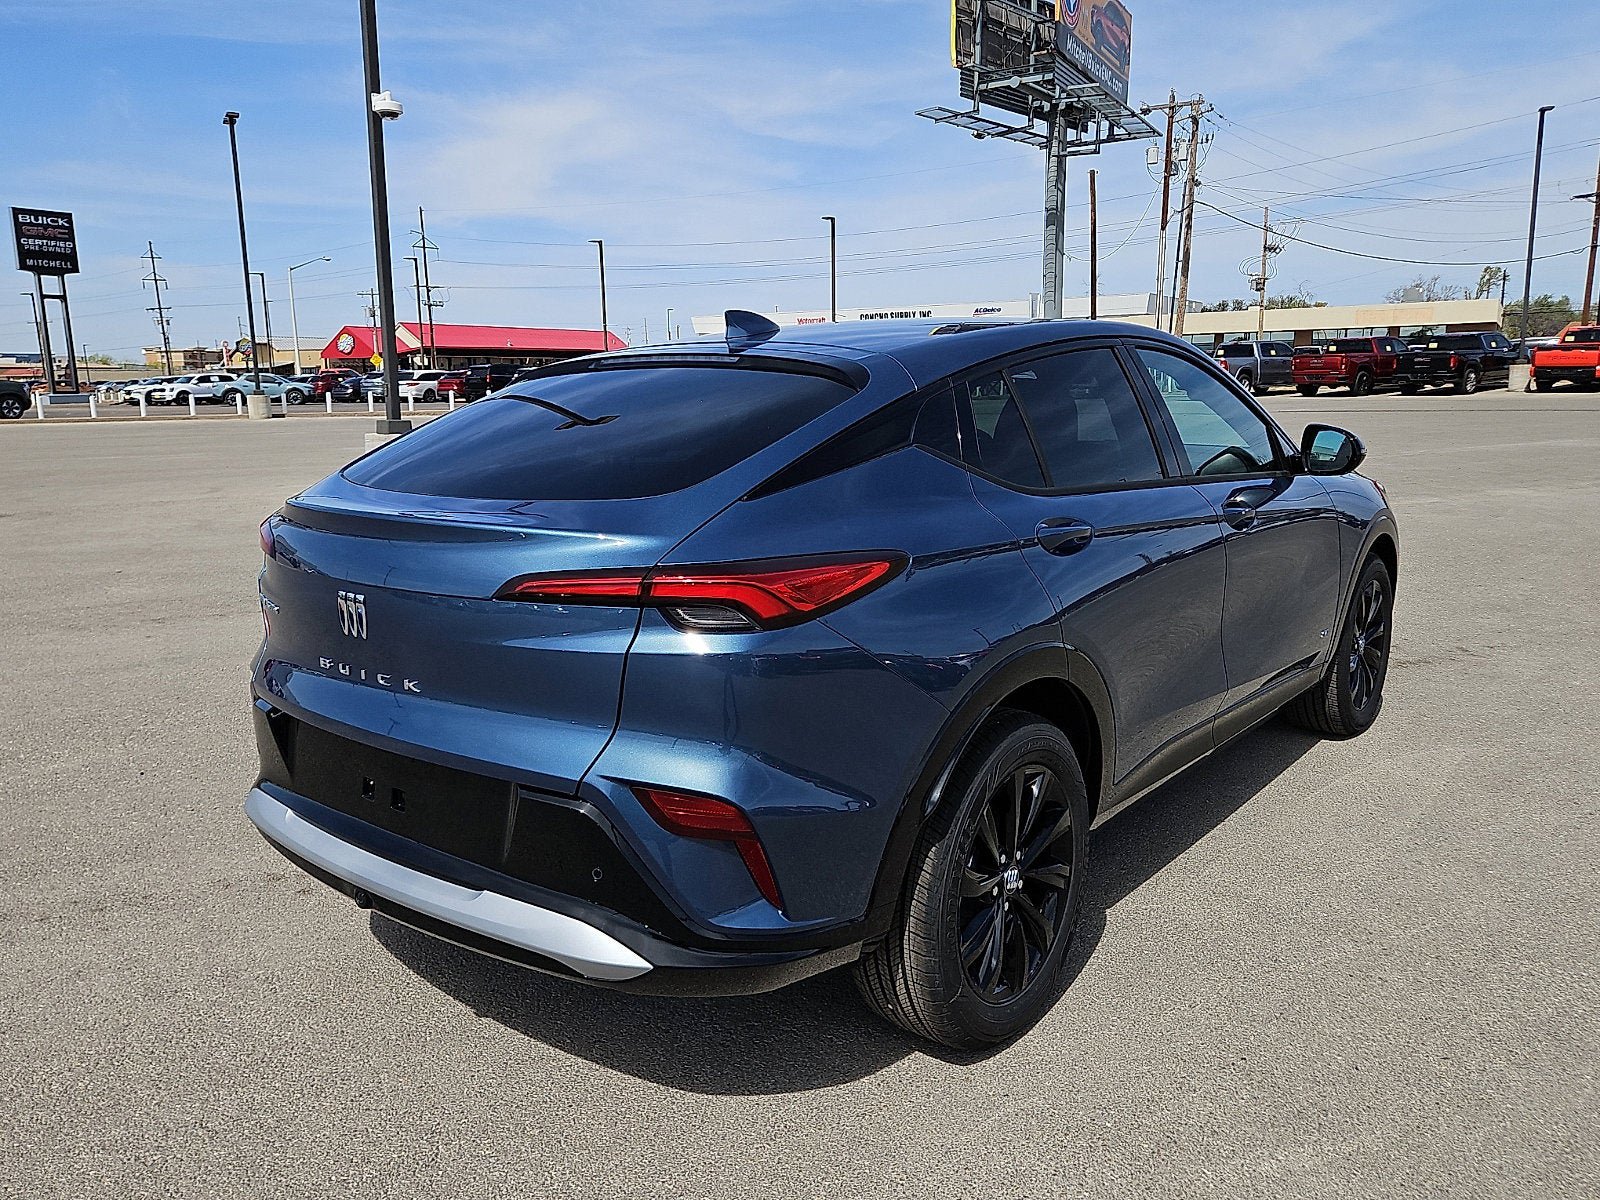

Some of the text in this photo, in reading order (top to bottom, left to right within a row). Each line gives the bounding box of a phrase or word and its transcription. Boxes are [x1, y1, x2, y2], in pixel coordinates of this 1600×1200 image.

[18, 214, 70, 226] BUICK
[22, 226, 69, 238] GMC
[20, 238, 73, 247] CERTIFIED
[24, 245, 71, 253] PRE-OWNED
[26, 259, 72, 268] MITCHELL
[890, 311, 917, 319] SUPPLY
[319, 656, 421, 693] BUICK
